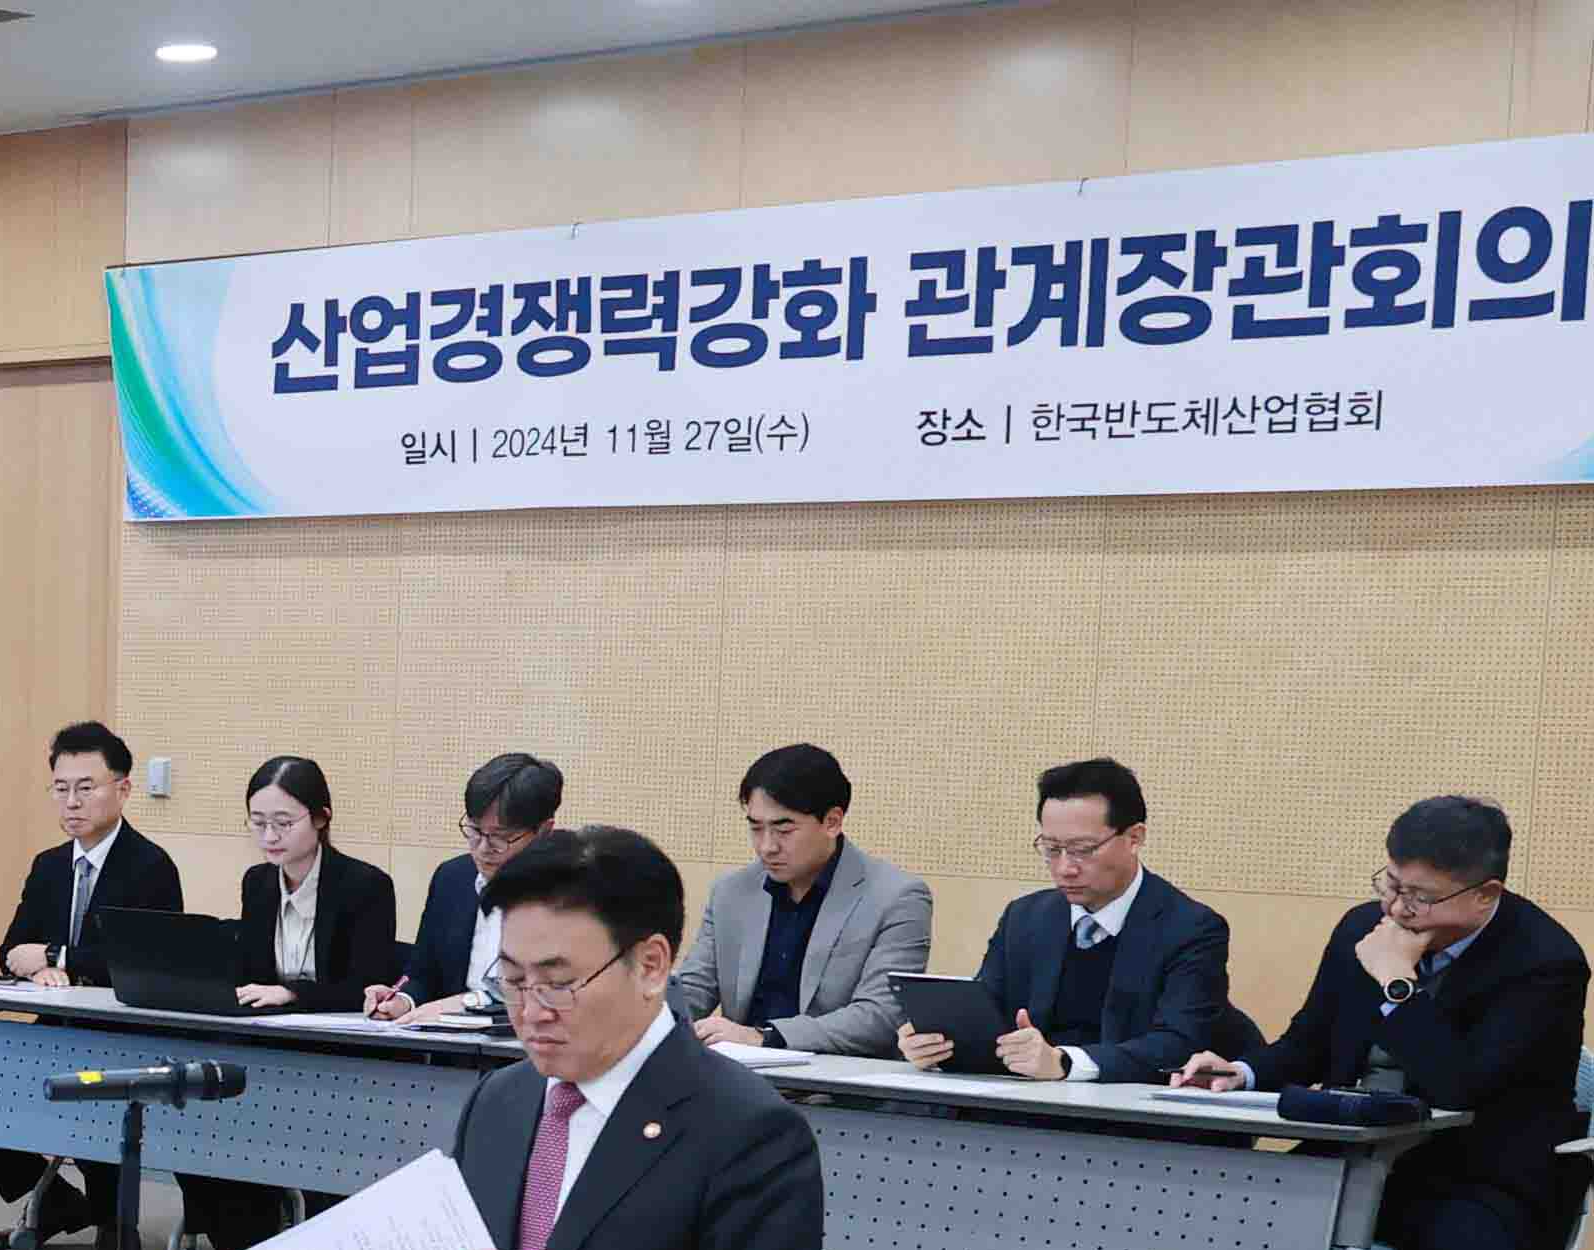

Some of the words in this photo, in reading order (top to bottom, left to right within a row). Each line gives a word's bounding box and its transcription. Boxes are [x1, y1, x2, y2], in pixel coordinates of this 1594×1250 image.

[270, 255, 879, 396] 산업경쟁력강화
[903, 198, 1594, 358] 관계장관회의
[399, 430, 458, 466] 일시
[490, 420, 589, 460] 2024년
[606, 418, 672, 456] 11월
[683, 411, 811, 456] 27일(수)
[915, 407, 989, 447] 장소
[1029, 389, 1384, 442] 한국반도체산업협회
